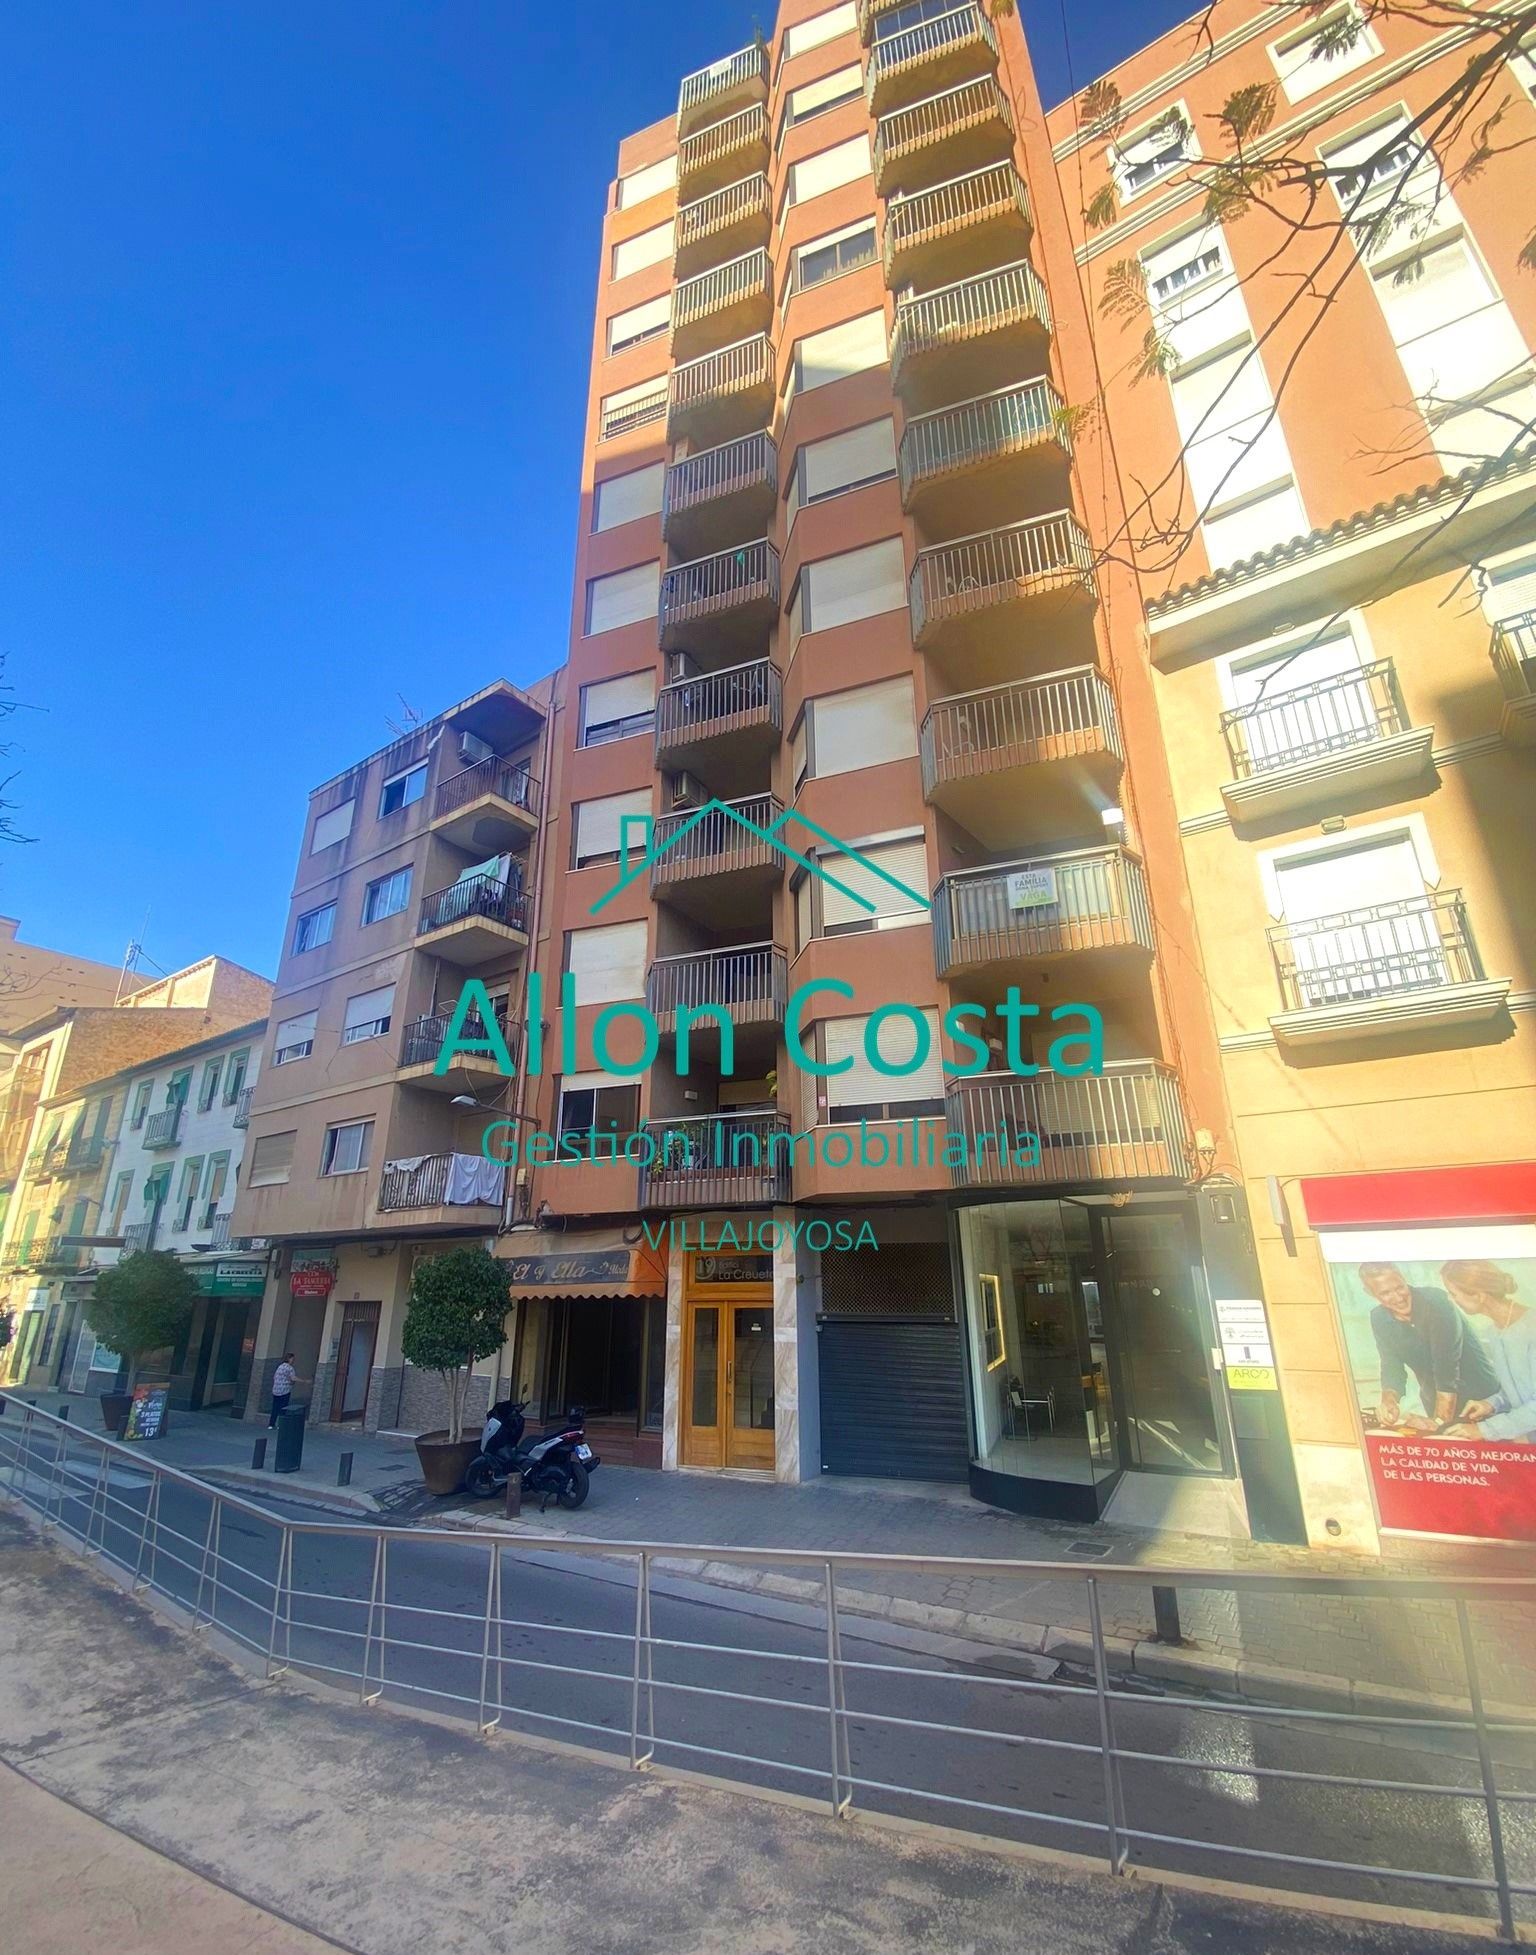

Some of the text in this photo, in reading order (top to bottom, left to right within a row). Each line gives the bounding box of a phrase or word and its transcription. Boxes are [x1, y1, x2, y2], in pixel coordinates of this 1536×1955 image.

[513, 1262, 531, 1280] El
[551, 1260, 588, 1279] Ella
[719, 1269, 731, 1280] La
[1379, 1443, 1404, 1455] MÁS
[1406, 1446, 1422, 1456] DE
[1424, 1447, 1440, 1457] 70
[1443, 1447, 1477, 1460] AÑOS
[1380, 1457, 1499, 1474] LA CALIDAD DE VIDA
[1383, 1470, 1491, 1487] DE LAS PERSONAS.
